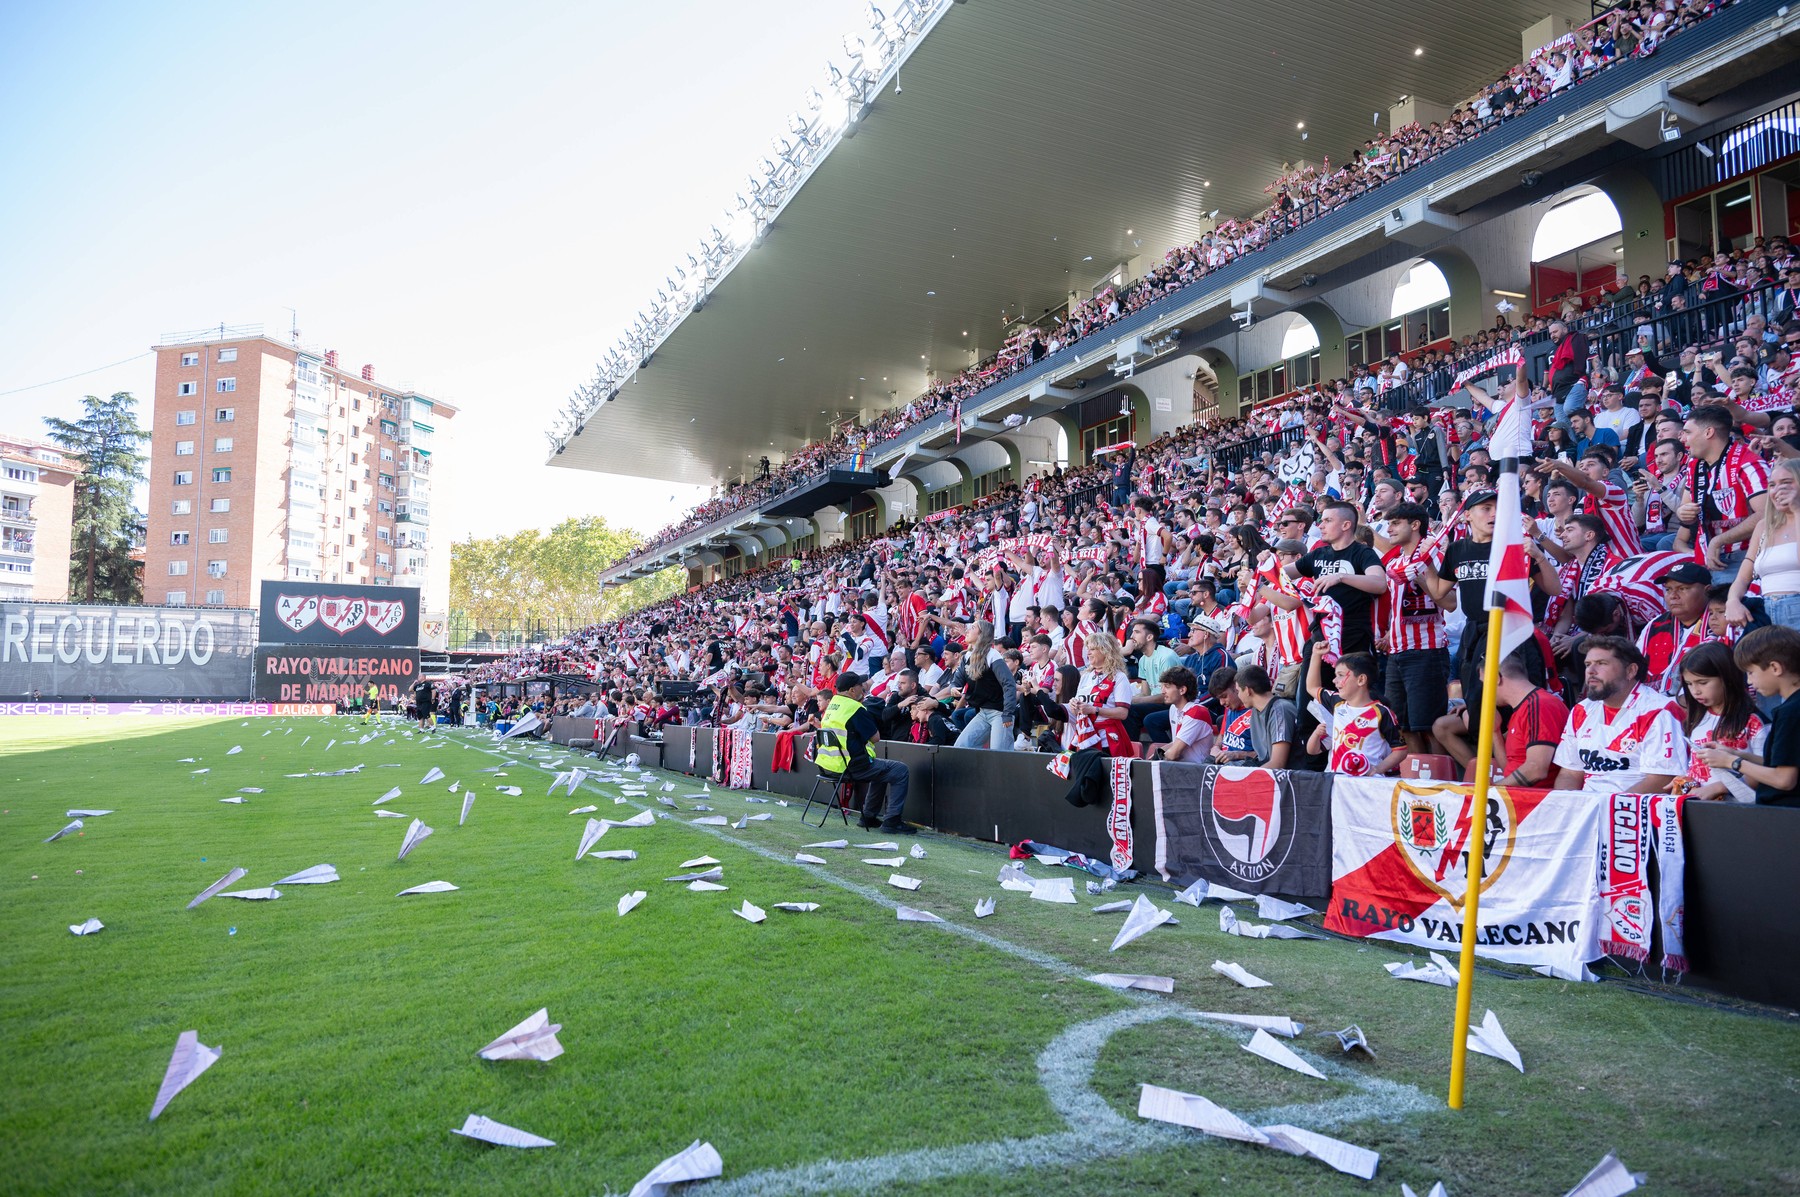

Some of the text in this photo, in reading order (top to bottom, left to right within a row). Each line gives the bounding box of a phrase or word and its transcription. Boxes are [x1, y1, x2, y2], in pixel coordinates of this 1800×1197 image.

[1314, 559, 1340, 568] VALLE
[3, 615, 215, 665] RECUERDO
[266, 657, 413, 675] RAYO VALLECANO
[281, 684, 301, 701] DE
[306, 684, 365, 701] MADRID
[373, 684, 398, 701] AD
[0, 704, 318, 715] SKECHERS SKECHERS LALIGA
[1204, 765, 1219, 790] AN
[1114, 804, 1127, 840] RAYO
[1665, 808, 1677, 853] Nobleza
[1230, 858, 1275, 878] AKTION
[1341, 898, 1415, 933] RAYO
